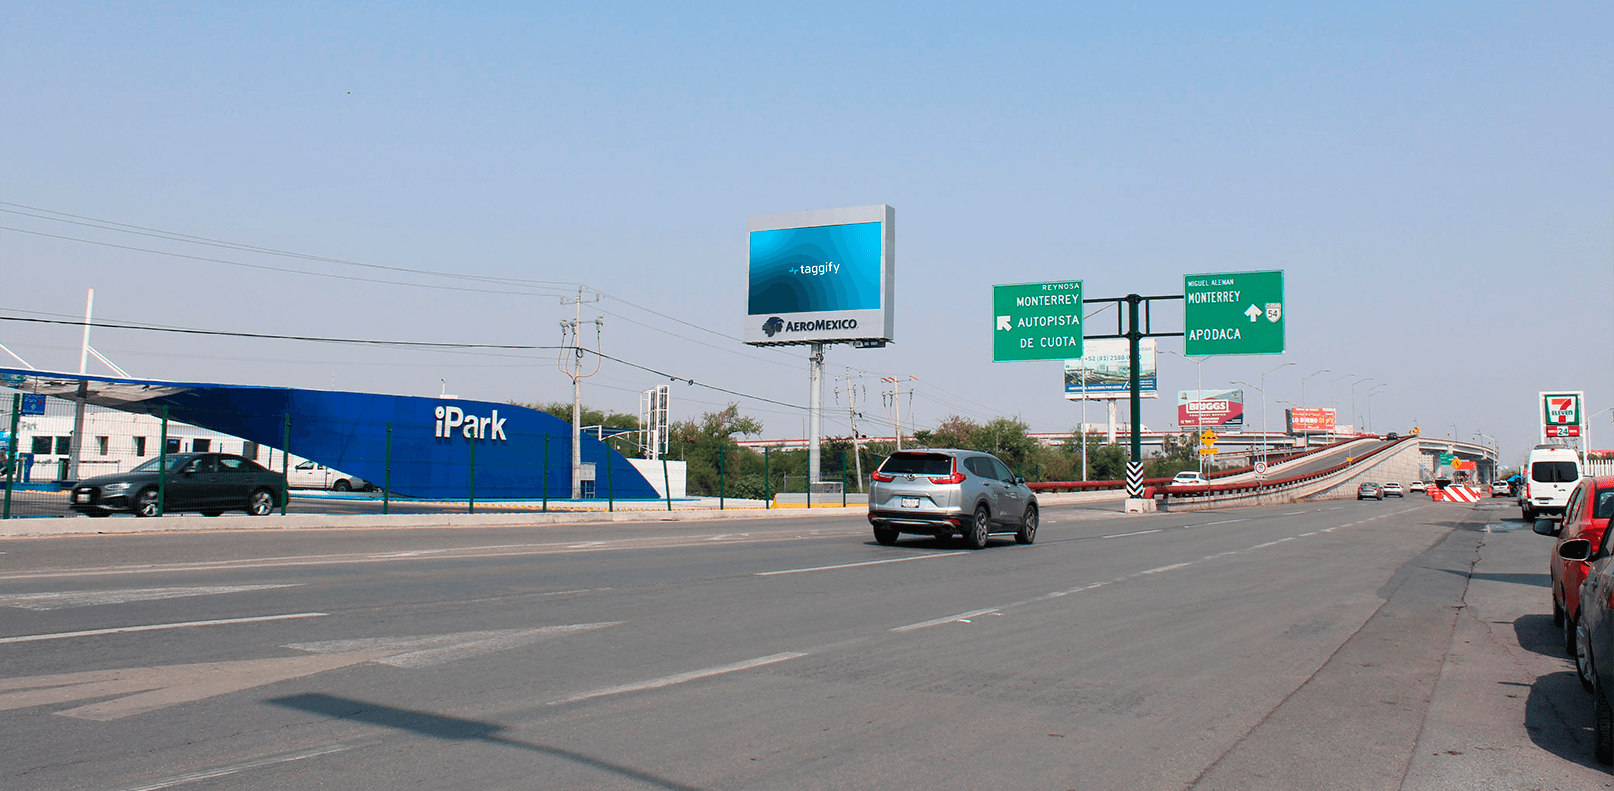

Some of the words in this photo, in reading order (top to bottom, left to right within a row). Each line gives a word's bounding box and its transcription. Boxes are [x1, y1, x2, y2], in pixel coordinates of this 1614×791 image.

[799, 261, 841, 276] taggify
[1042, 282, 1080, 291] REYNOSA
[1187, 280, 1210, 288] MIGUEL
[1211, 278, 1235, 287] ALEMAN
[1016, 293, 1080, 307] MONTERREY
[1188, 290, 1241, 304] MONTERREY
[1017, 314, 1080, 328] AUTOPISTA
[1268, 309, 1278, 319] 54
[1188, 327, 1242, 341] APODACA
[1020, 337, 1035, 349] DE
[1040, 336, 1077, 348] CUOTA
[1189, 402, 1226, 411] BRIGGS
[1551, 398, 1572, 423] 7
[434, 405, 508, 441] iPark
[1557, 427, 1569, 436] 24
